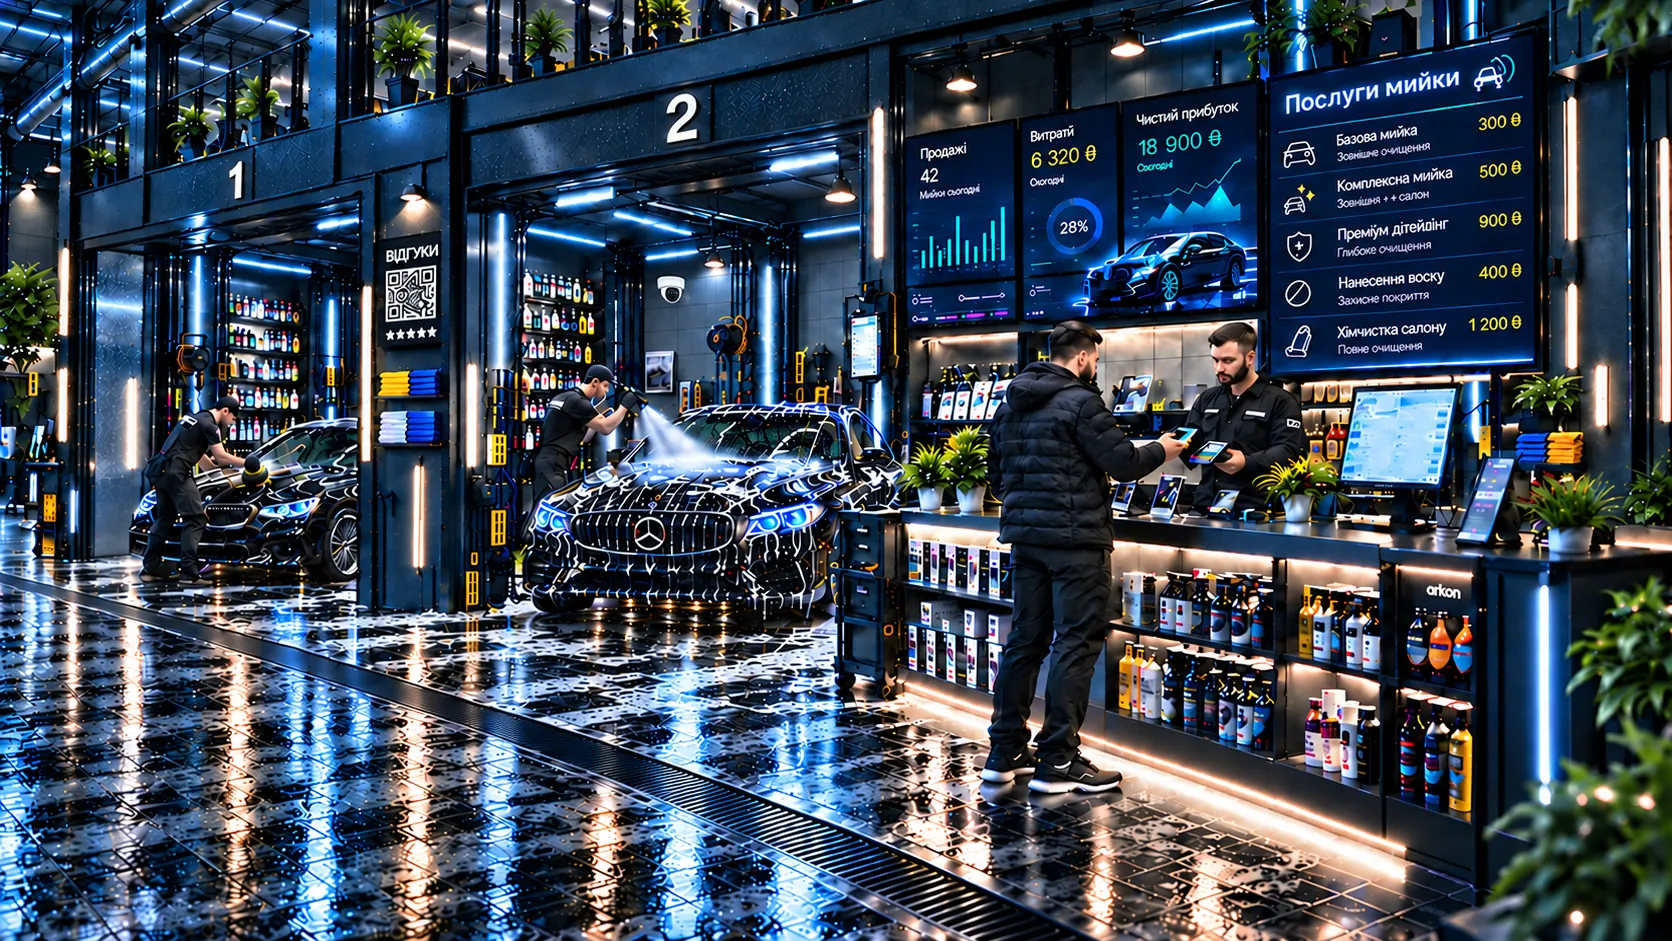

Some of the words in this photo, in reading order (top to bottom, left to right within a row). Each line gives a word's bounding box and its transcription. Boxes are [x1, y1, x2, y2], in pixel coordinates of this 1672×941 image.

[1285, 84, 1379, 115] Послуги
[1386, 71, 1460, 97] мийки
[666, 93, 698, 143] 2
[1136, 108, 1179, 126] Чистий
[1182, 102, 1239, 122] прибуток
[1478, 115, 1507, 131] 300
[1138, 138, 1158, 156] 18
[1166, 131, 1203, 153] 900
[1336, 131, 1377, 147] Базова
[1380, 125, 1418, 140] мийка
[920, 142, 967, 162] Продажі
[1381, 142, 1431, 156] очищення
[1031, 152, 1042, 169] 6
[1048, 147, 1080, 167] 320
[920, 168, 939, 183] 42
[1479, 162, 1508, 179] 500
[229, 160, 243, 199] 1
[1337, 173, 1410, 192] Комплексна
[1413, 167, 1454, 181] мийка
[1398, 190, 1430, 202] салон
[1060, 219, 1089, 235] 28%
[1479, 213, 1508, 228] 900
[385, 243, 439, 264] ВІДГУКИ
[1337, 246, 1377, 258] Глибоке
[1379, 241, 1432, 254] очищення
[1338, 275, 1405, 290] Нанесення
[1408, 271, 1446, 285] воску
[1479, 265, 1508, 280] 400
[1338, 294, 1380, 306] Захисне
[1382, 291, 1430, 304] покриття
[1337, 325, 1399, 339] Хімчистка
[1401, 322, 1448, 337] салону
[1468, 318, 1476, 332] 1
[1480, 316, 1508, 331] 200
[1338, 344, 1370, 355] Повне
[1371, 342, 1423, 354] очищення
[1426, 583, 1462, 600] arkon
